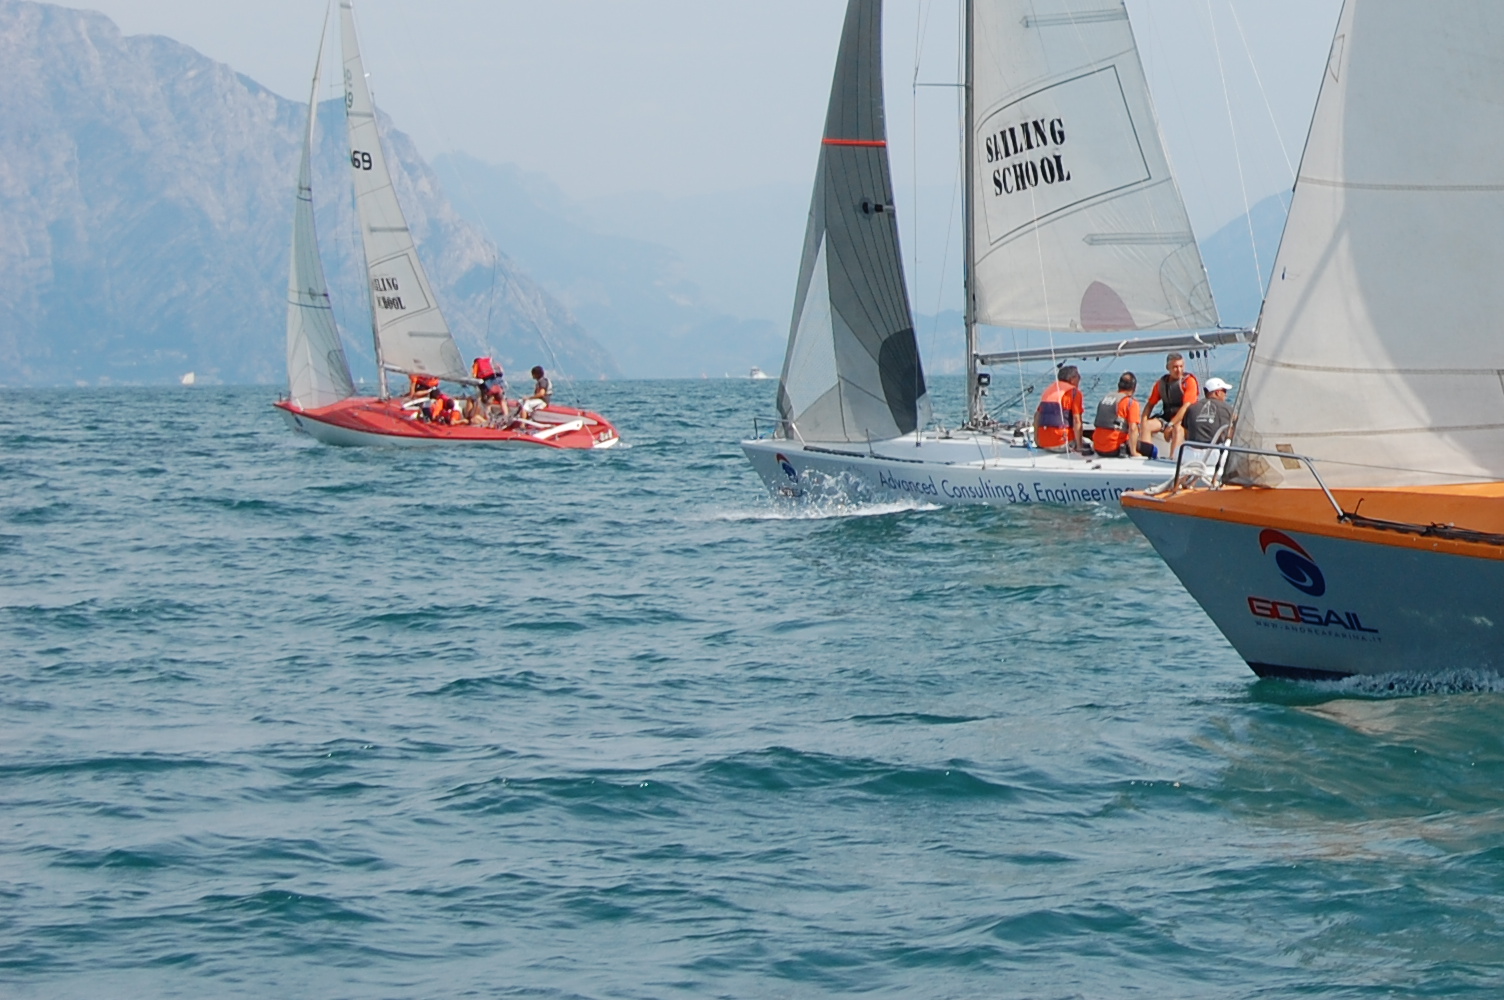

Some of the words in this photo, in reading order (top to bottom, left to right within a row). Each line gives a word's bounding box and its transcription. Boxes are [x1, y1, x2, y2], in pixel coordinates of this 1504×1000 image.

[985, 118, 1066, 163] SAILING
[992, 154, 1071, 197] SCHOOL
[879, 469, 938, 496] Advanced
[941, 476, 1017, 503] Consulting
[1017, 482, 1031, 502] &
[1033, 481, 1135, 504] Engineerin
